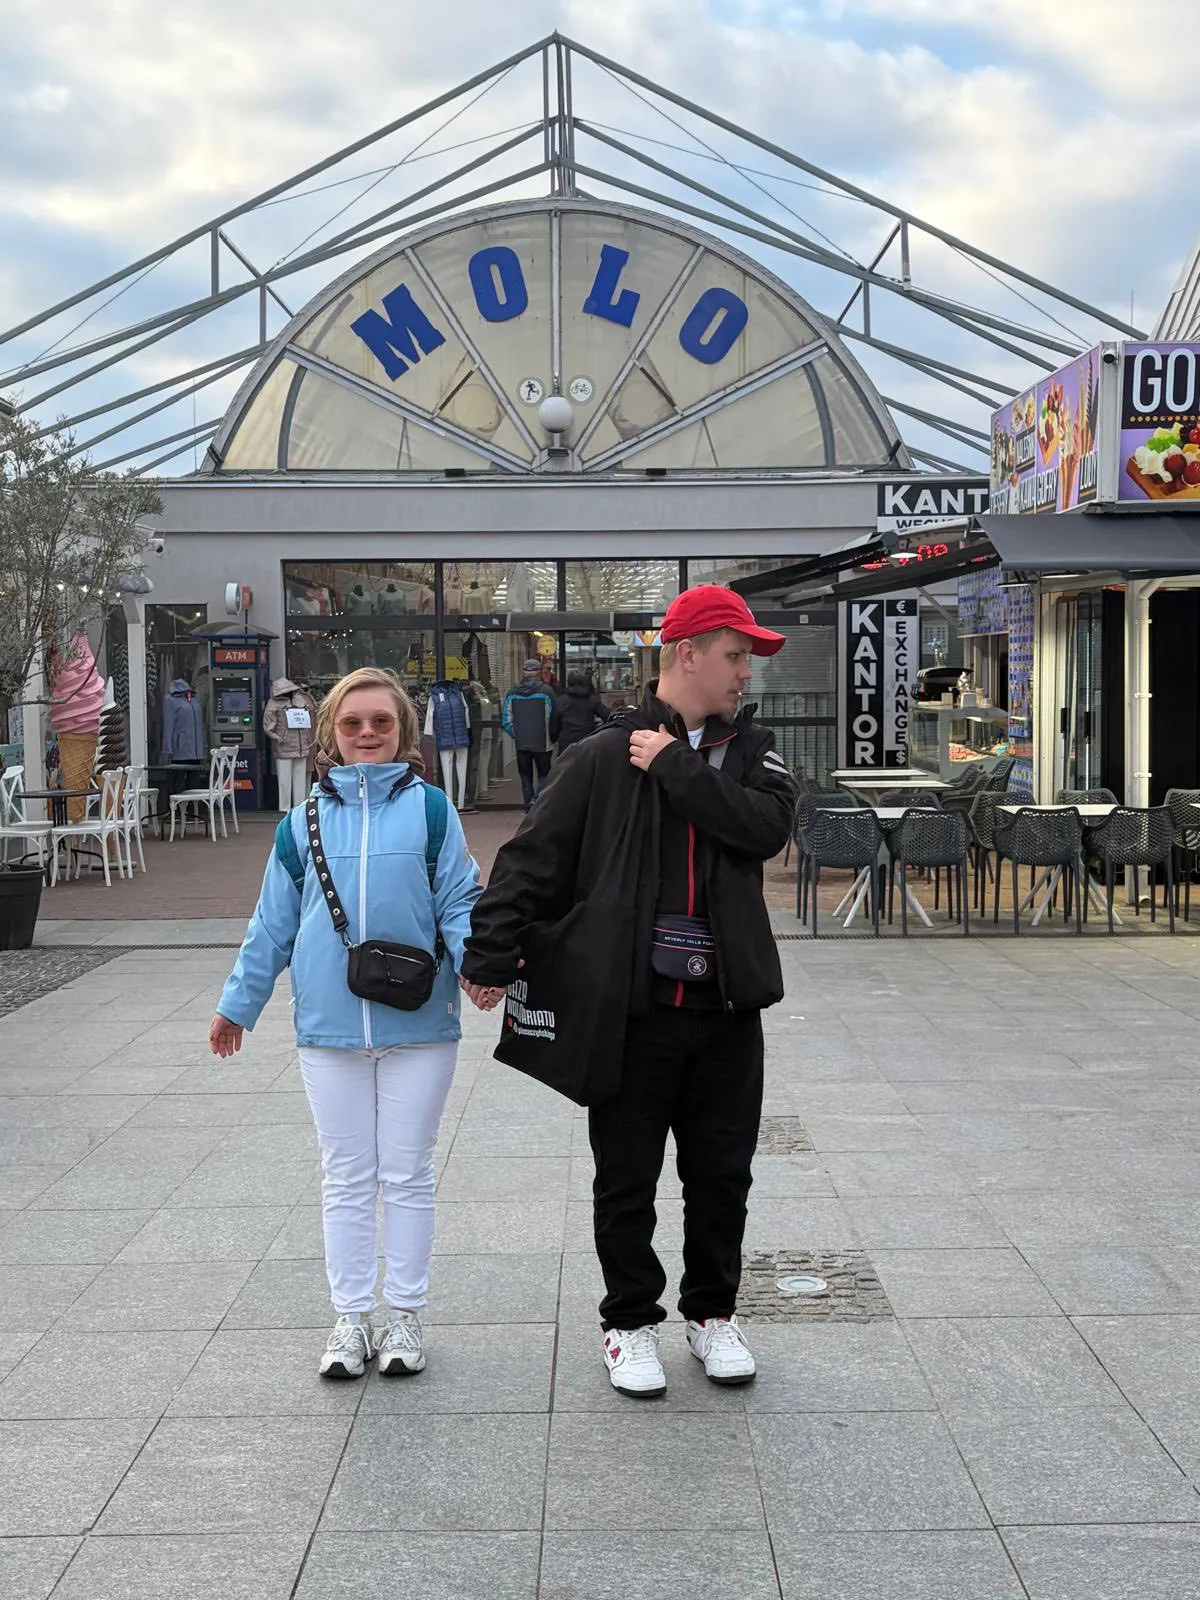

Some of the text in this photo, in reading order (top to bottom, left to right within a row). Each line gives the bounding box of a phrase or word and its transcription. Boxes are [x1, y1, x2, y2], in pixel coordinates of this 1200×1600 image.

[350, 244, 749, 381] MOLO
[1132, 348, 1200, 413] GO
[884, 484, 989, 515] KANT
[1036, 466, 1059, 506] GOFRY
[224, 651, 247, 661] ATM
[851, 603, 880, 765] KANTOR
[895, 621, 908, 745] EXCHANGE
